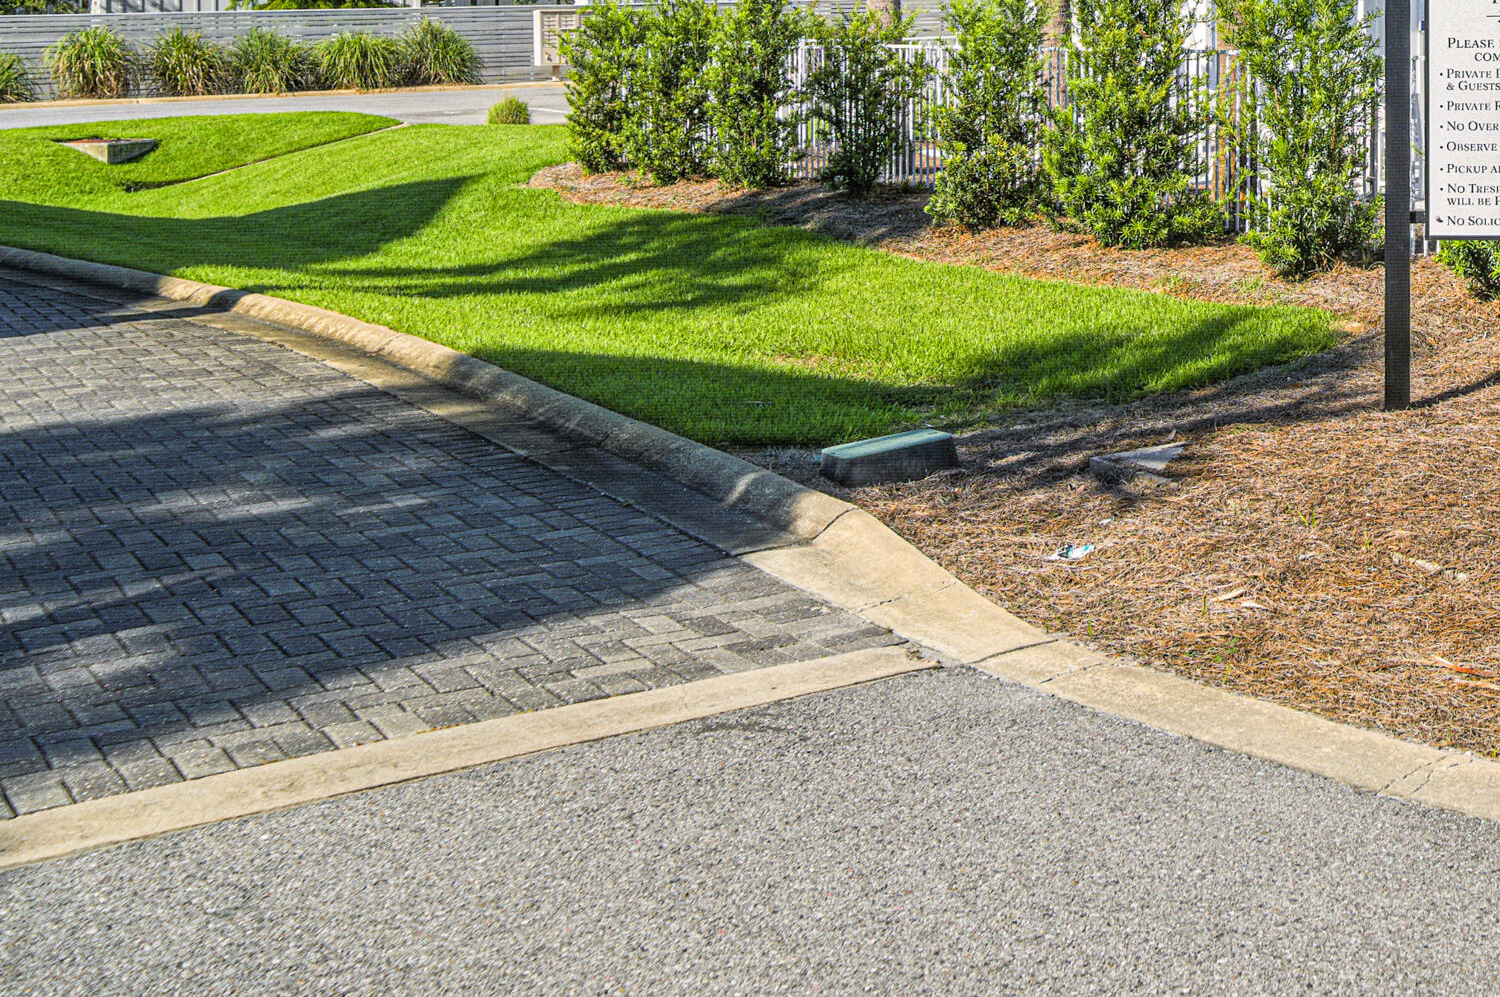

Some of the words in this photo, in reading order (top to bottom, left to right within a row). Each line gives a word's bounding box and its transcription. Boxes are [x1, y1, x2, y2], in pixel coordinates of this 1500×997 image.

[1447, 37, 1495, 49] PLEASE
[1446, 68, 1492, 79] PRIVATE
[1446, 82, 1455, 91] &
[1458, 80, 1500, 91] GUESTS
[1447, 100, 1491, 111] PRIVATE
[1446, 120, 1465, 132] NO
[1446, 141, 1498, 152] OBSERVE
[1447, 163, 1488, 174] PICKUP
[1447, 183, 1466, 194] NO
[1447, 197, 1475, 206] WILL
[1477, 197, 1492, 206] BE
[1447, 215, 1465, 226] NO
